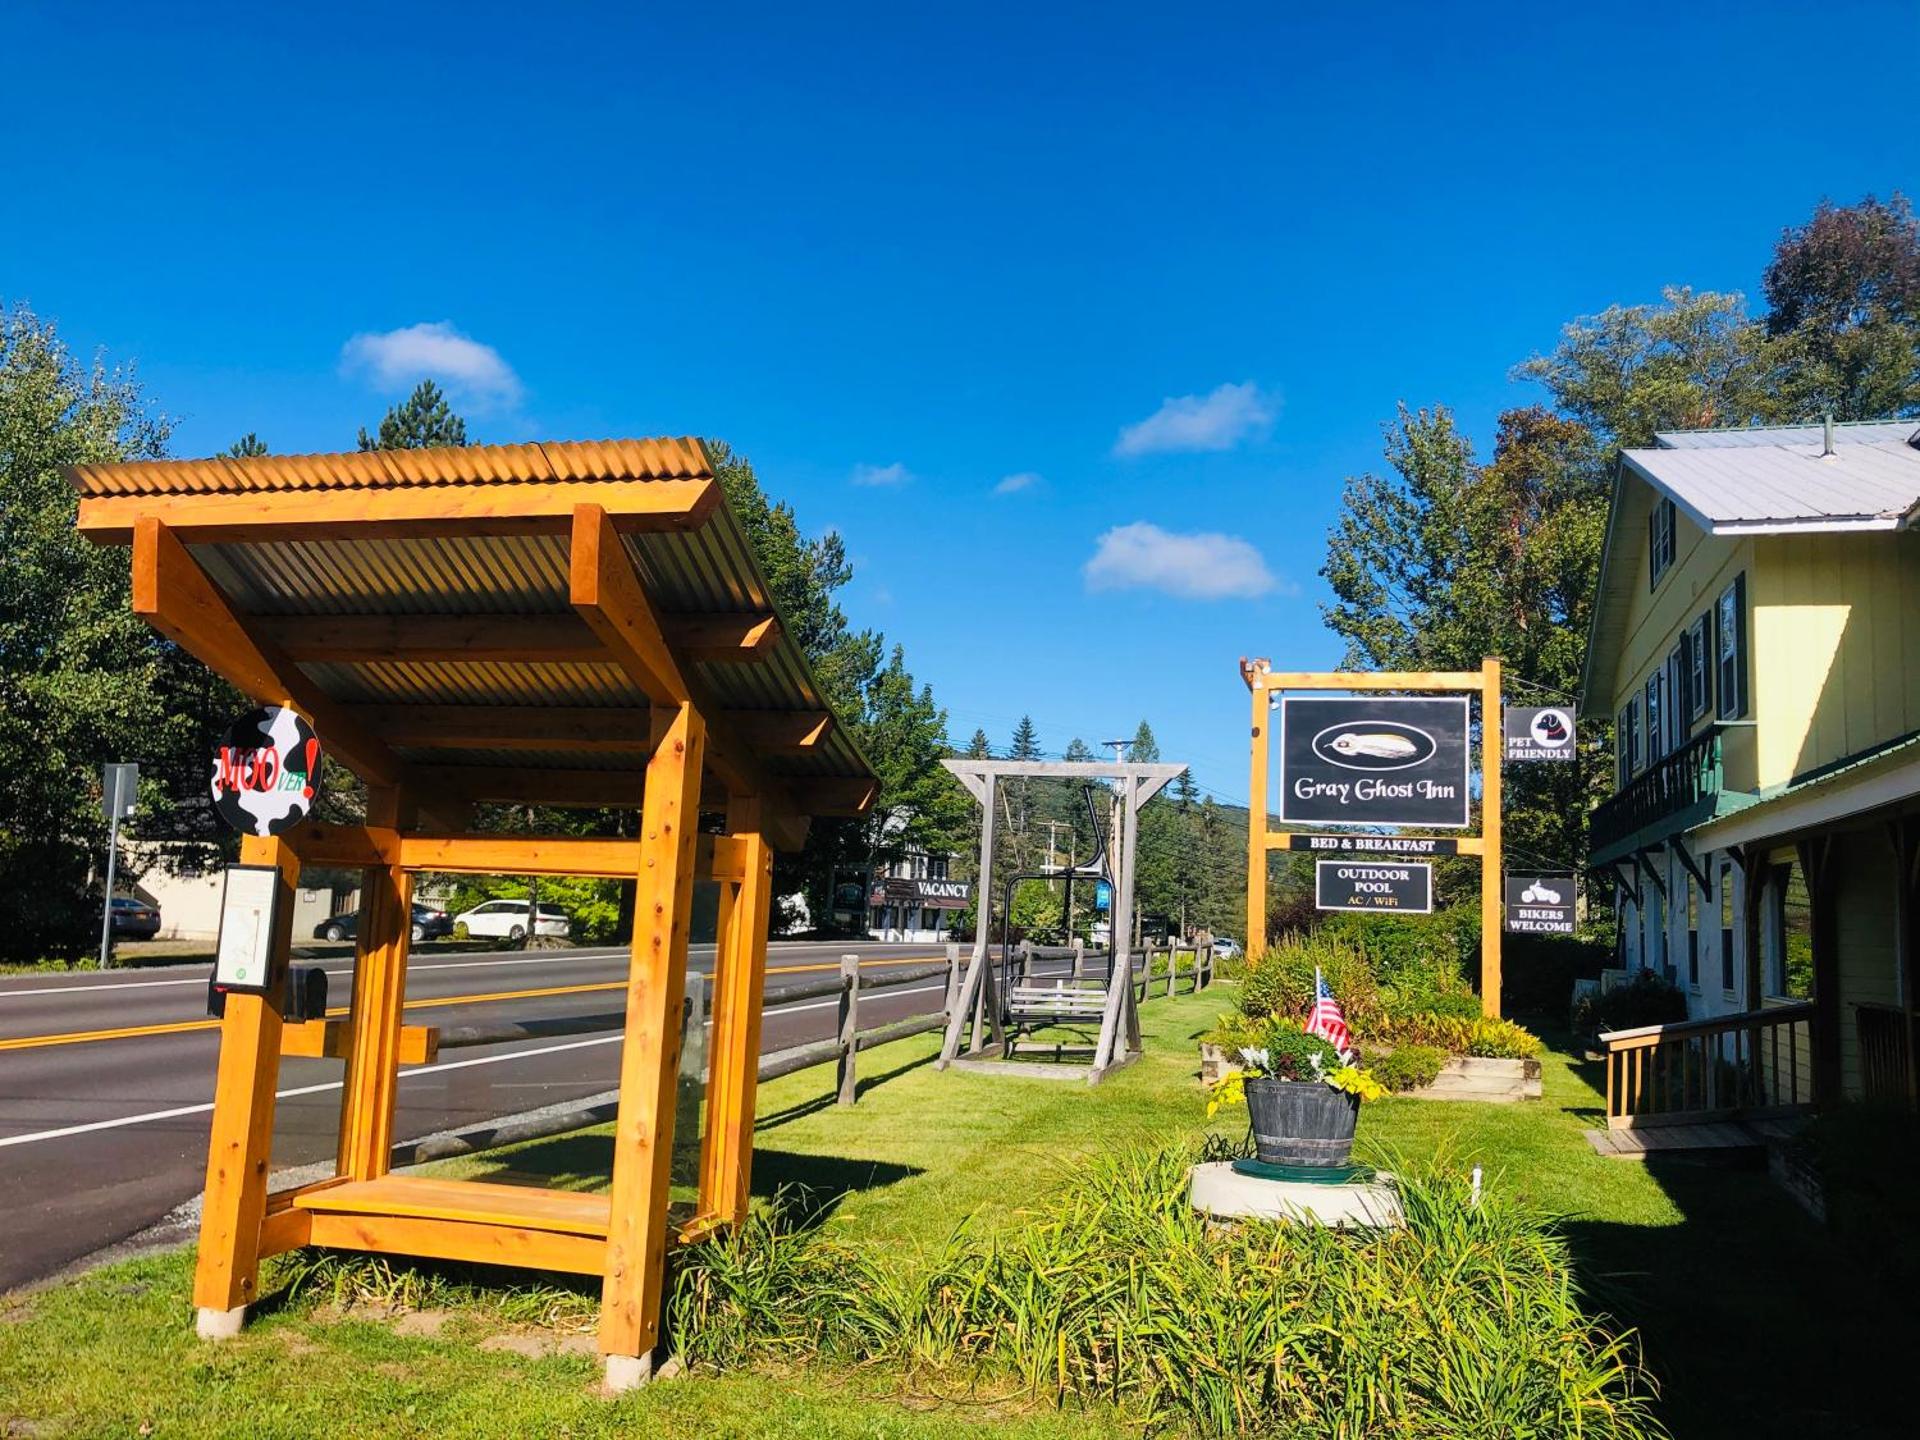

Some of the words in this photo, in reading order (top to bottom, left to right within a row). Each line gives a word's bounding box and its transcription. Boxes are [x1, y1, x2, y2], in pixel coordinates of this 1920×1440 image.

[1508, 737, 1533, 748] PET
[1508, 748, 1571, 759] FRIENDLY
[1294, 777, 1350, 804] Gray
[1355, 778, 1413, 801] Ghost
[1417, 780, 1455, 800] Inn
[1310, 837, 1338, 849] BED
[1341, 838, 1352, 850] &
[1355, 839, 1436, 852] BREAKFAST
[1337, 868, 1410, 881] OUTDOOR
[918, 882, 969, 898] VACANCY
[1354, 881, 1393, 893] POOL
[1347, 896, 1364, 906] AC
[1373, 896, 1399, 907] WiFi
[1519, 909, 1564, 920] BIKERS
[1510, 920, 1573, 932] WELCOME
